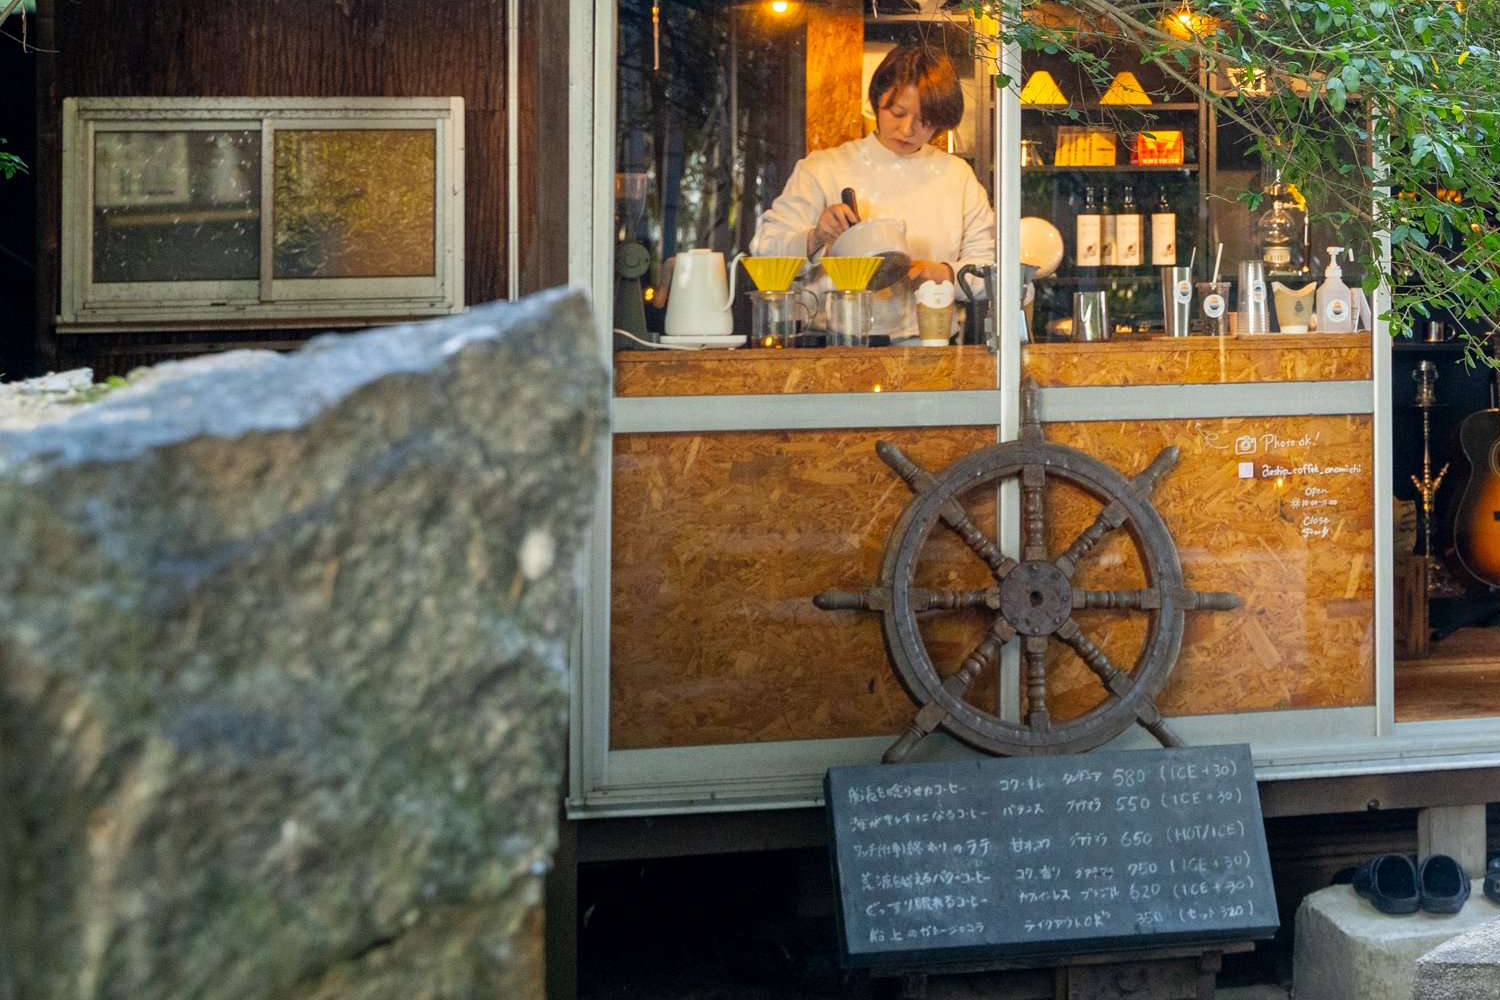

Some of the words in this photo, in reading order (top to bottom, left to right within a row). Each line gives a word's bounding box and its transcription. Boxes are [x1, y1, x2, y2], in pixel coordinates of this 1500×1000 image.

[1259, 433, 1296, 452] Photo
[1303, 516, 1330, 526] Close
[1112, 768, 1146, 787] 580
[1116, 796, 1150, 812] 550
[1120, 831, 1153, 847] 650
[1130, 883, 1161, 900] 620
